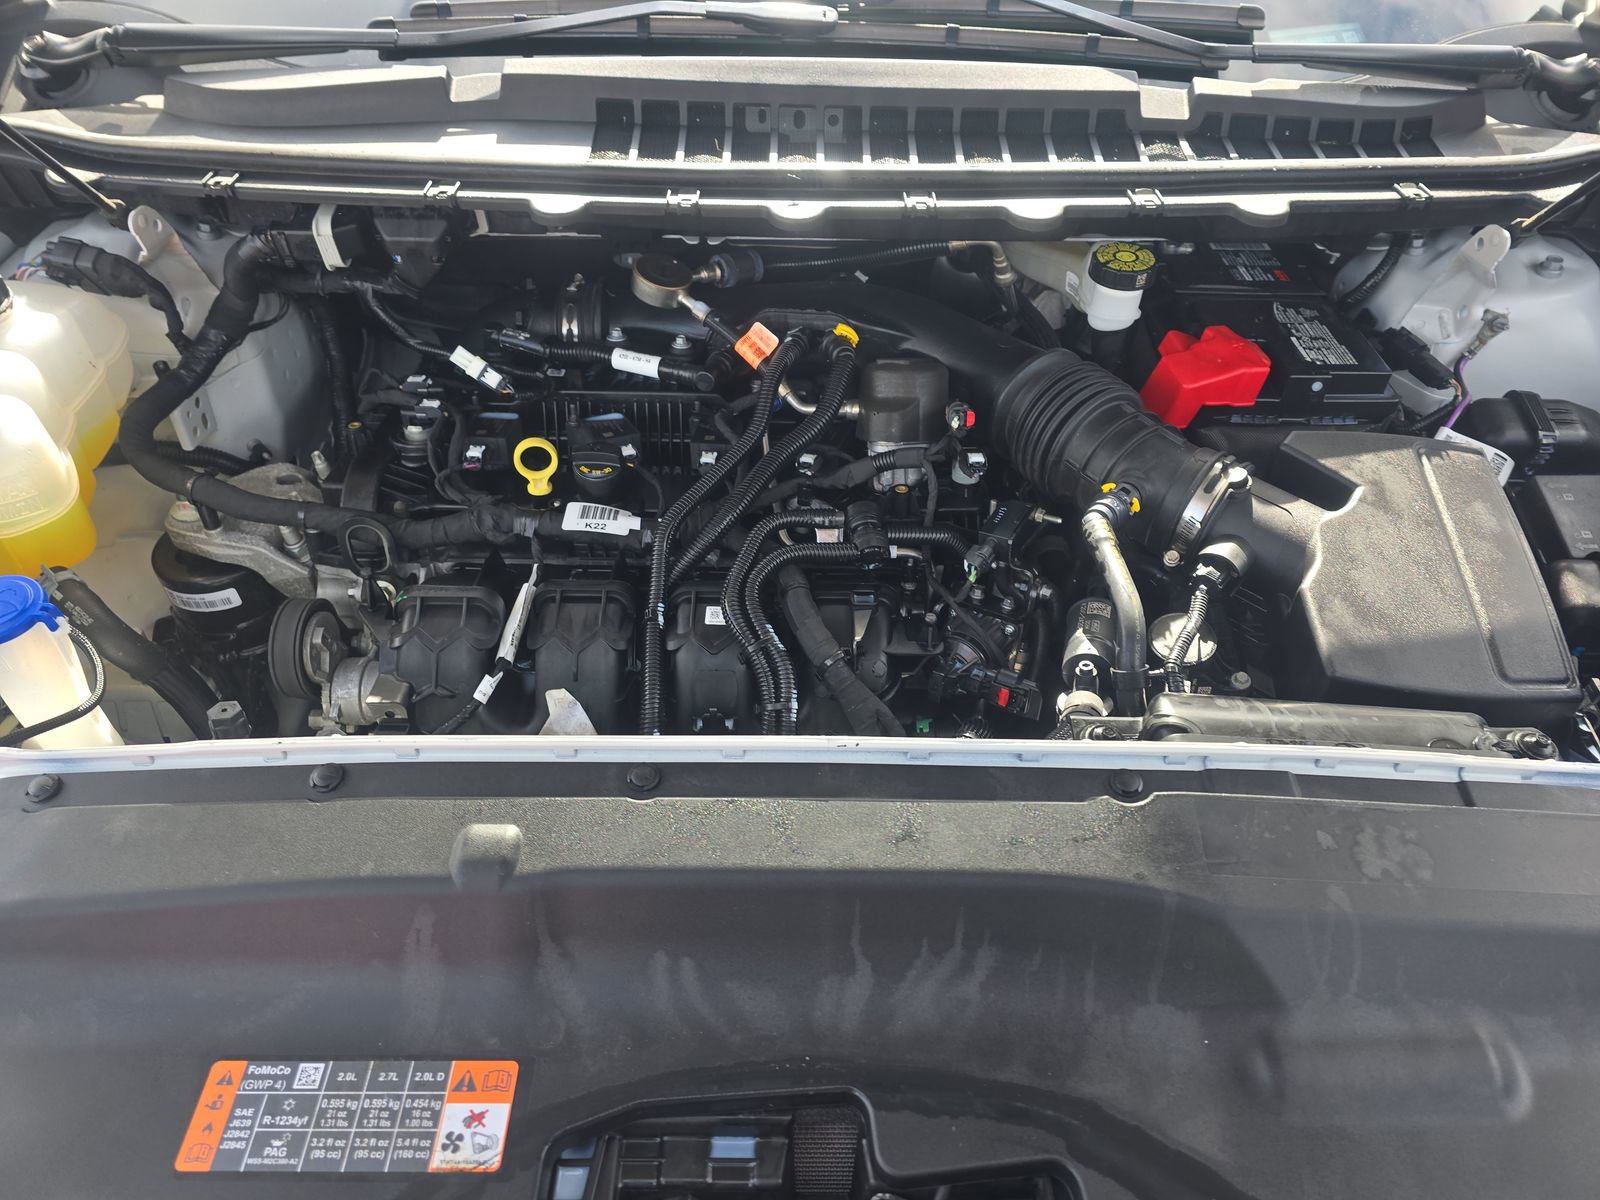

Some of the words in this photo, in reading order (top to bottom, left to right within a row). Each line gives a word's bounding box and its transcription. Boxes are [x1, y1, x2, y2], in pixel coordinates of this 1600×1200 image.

[584, 522, 607, 530] K22
[247, 1065, 291, 1075] FoMoCo
[337, 1072, 358, 1081] 2.0L
[378, 1072, 399, 1081] 2.7L
[414, 1072, 435, 1081] 2.0L
[437, 1072, 446, 1081] D
[240, 1079, 273, 1092] (GWP
[274, 1079, 286, 1092] 4)
[321, 1098, 347, 1109] 0.595
[347, 1098, 358, 1111] kg
[363, 1098, 388, 1109] 0.595
[388, 1098, 400, 1111] kg
[405, 1098, 429, 1109] 0.454
[430, 1098, 442, 1111] kg
[234, 1108, 255, 1117] SAE
[337, 1110, 348, 1118] oz
[380, 1110, 390, 1118] oz
[422, 1110, 432, 1118] oz
[229, 1119, 252, 1128] J639
[262, 1115, 309, 1128] R-1234yf
[336, 1119, 349, 1127] lbs
[379, 1119, 391, 1127] lbs
[421, 1119, 433, 1127] lbs
[310, 1138, 326, 1147] 3.2
[326, 1138, 334, 1147] fl
[334, 1138, 346, 1147] oz
[353, 1138, 369, 1147] 3.2
[369, 1138, 377, 1147] fl
[377, 1138, 389, 1147] oz
[395, 1138, 410, 1147] 5.4
[411, 1138, 419, 1147] fl
[419, 1138, 431, 1147] oz
[263, 1147, 288, 1157] PAG
[310, 1150, 326, 1160] (95
[327, 1150, 342, 1160] cc)
[353, 1150, 369, 1160] (95
[370, 1150, 385, 1160] cc)
[393, 1150, 414, 1160] (160
[415, 1150, 430, 1160] cc)
